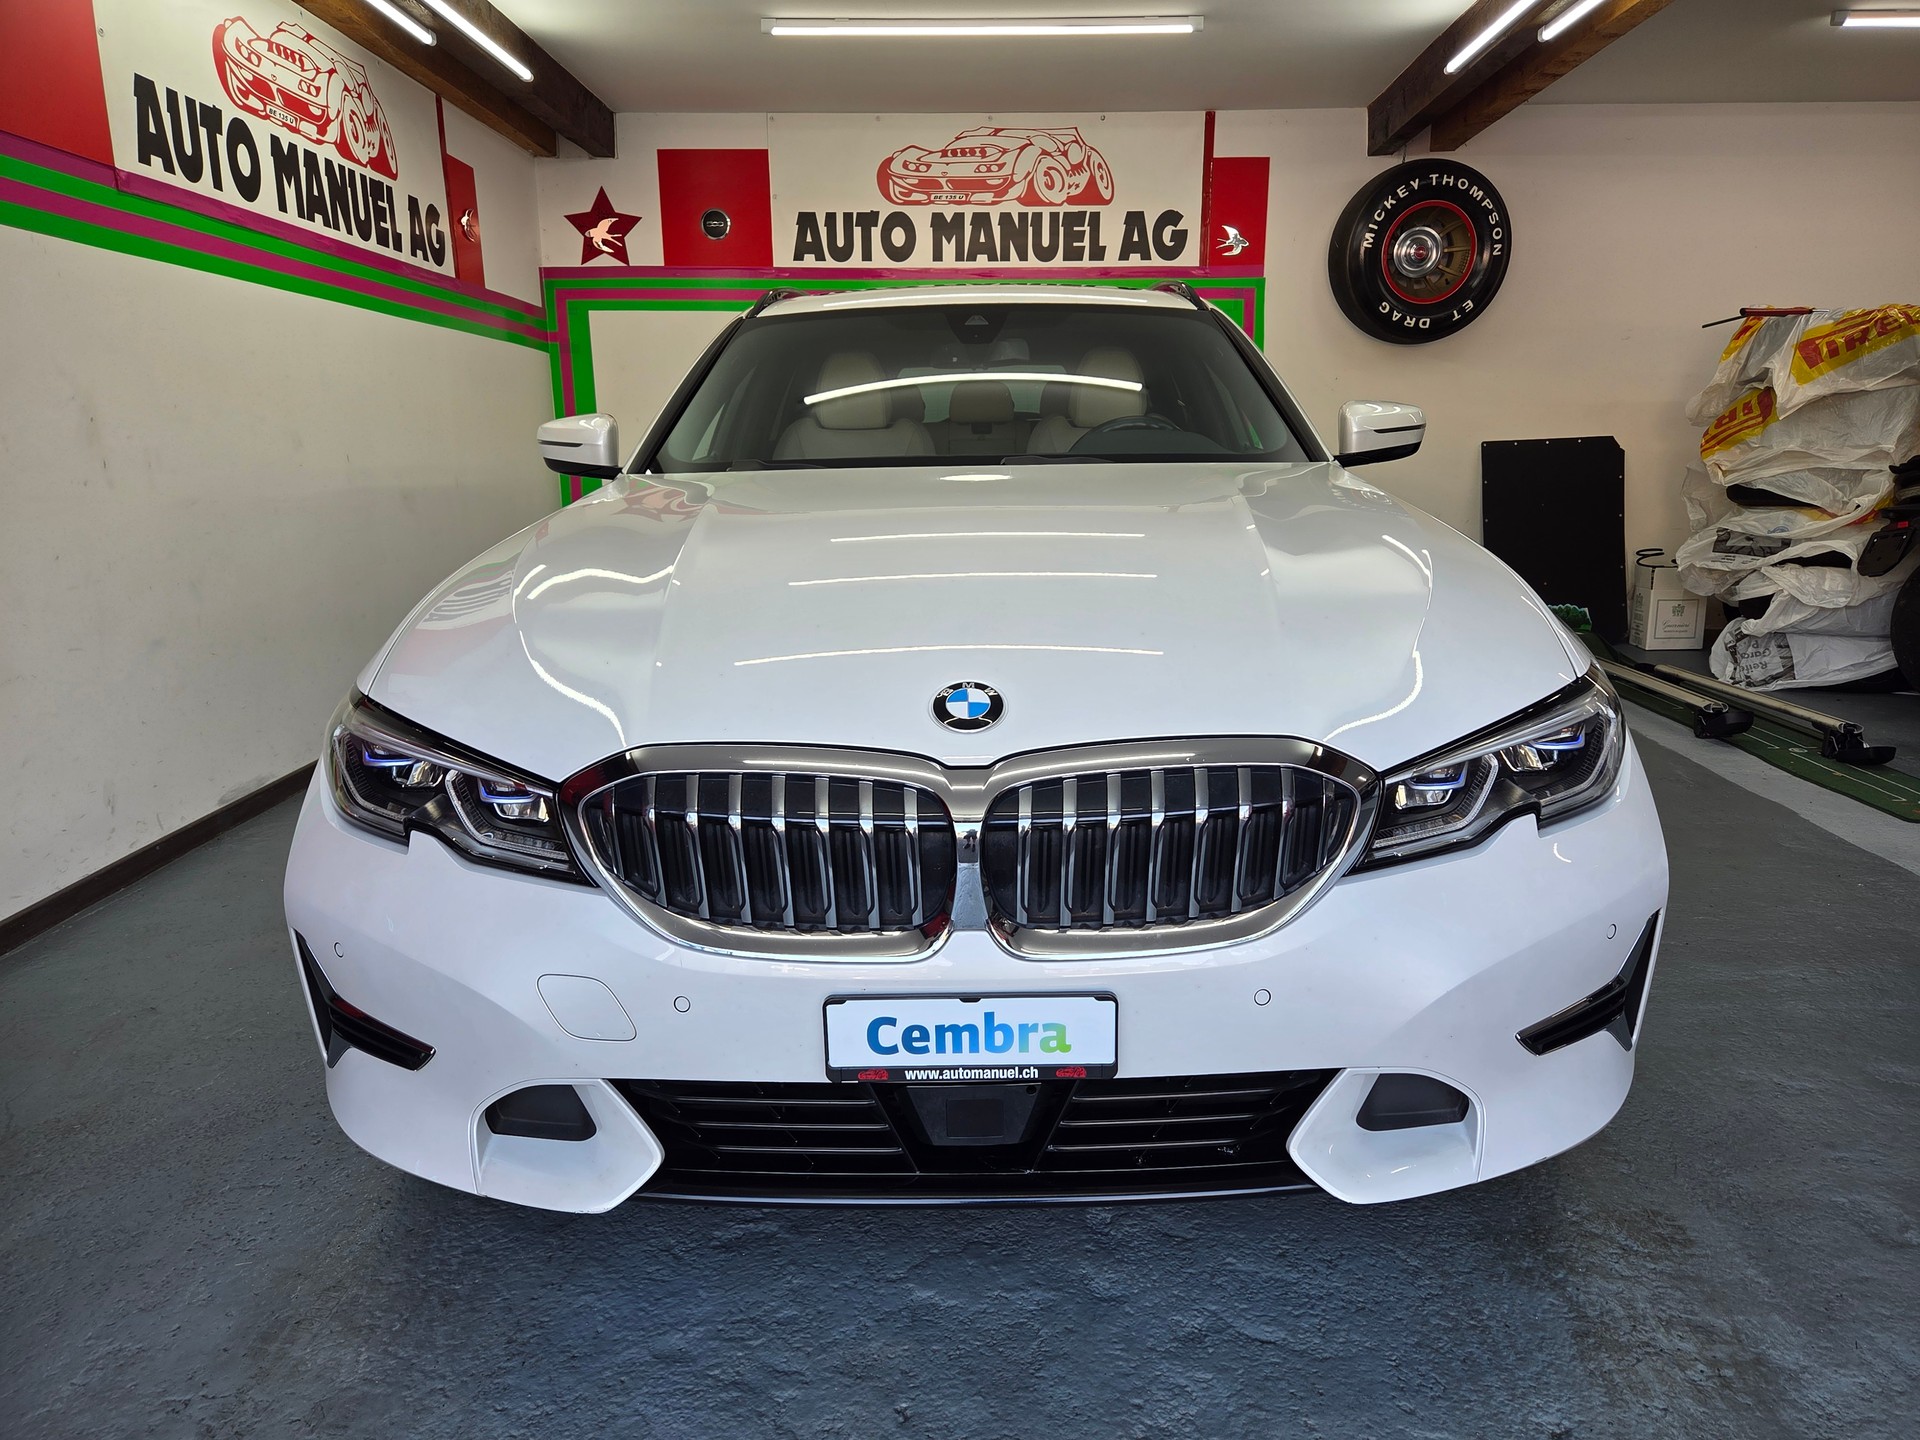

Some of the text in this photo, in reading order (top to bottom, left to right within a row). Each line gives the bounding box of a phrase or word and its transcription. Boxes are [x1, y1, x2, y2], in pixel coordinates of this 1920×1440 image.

[133, 72, 445, 267] AUTO MANUEL AG
[793, 209, 1188, 262] AUTO MANUEL AG
[1362, 173, 1503, 256] MICKEY THOMPSON
[1379, 300, 1474, 329] ET DRAG
[937, 682, 998, 698] BMW
[866, 1011, 1072, 1055] Cembra
[904, 1066, 1039, 1080] www.automanuel.ch
